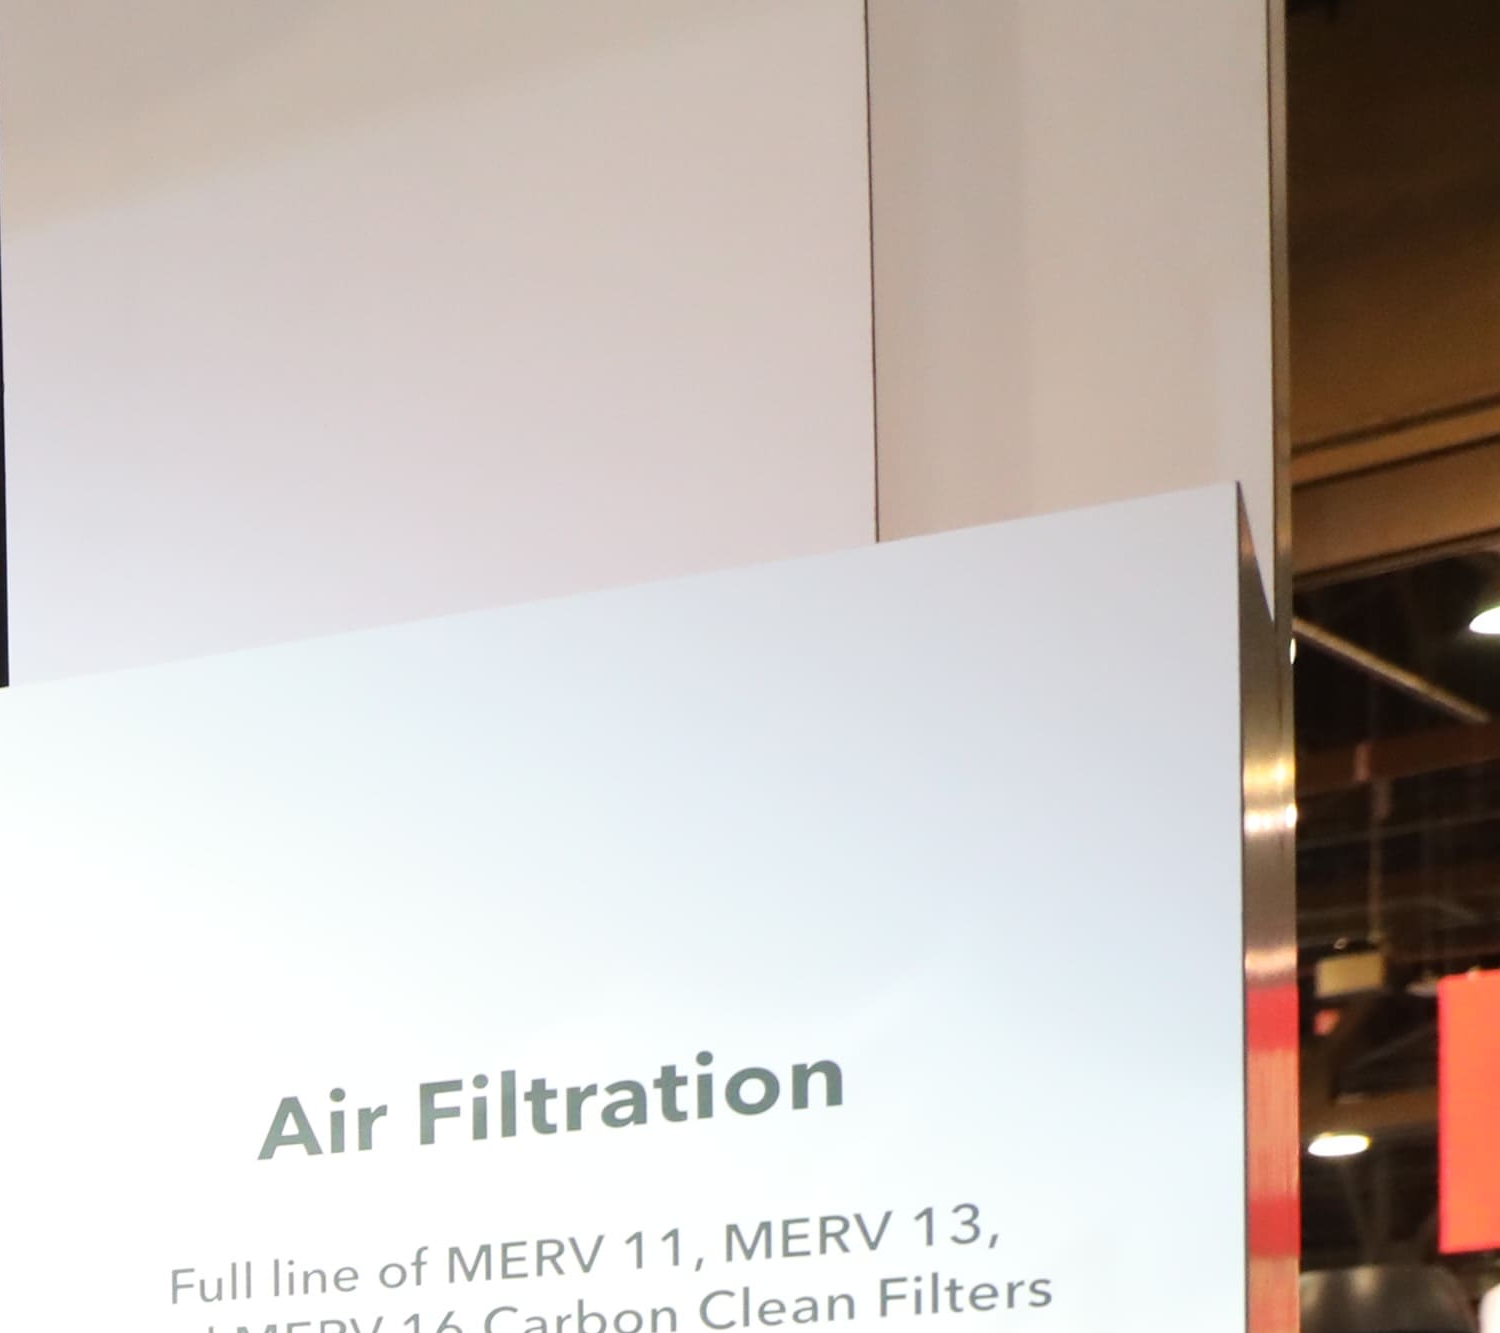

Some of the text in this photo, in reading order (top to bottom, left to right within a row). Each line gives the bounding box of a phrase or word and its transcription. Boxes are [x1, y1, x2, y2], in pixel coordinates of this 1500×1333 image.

[257, 1050, 844, 1161] Air Filtration
[169, 1201, 1000, 1305] Full line of MERV 11, MERV 13,
[698, 1284, 857, 1332] Clean
[877, 1269, 1054, 1321] Filters
